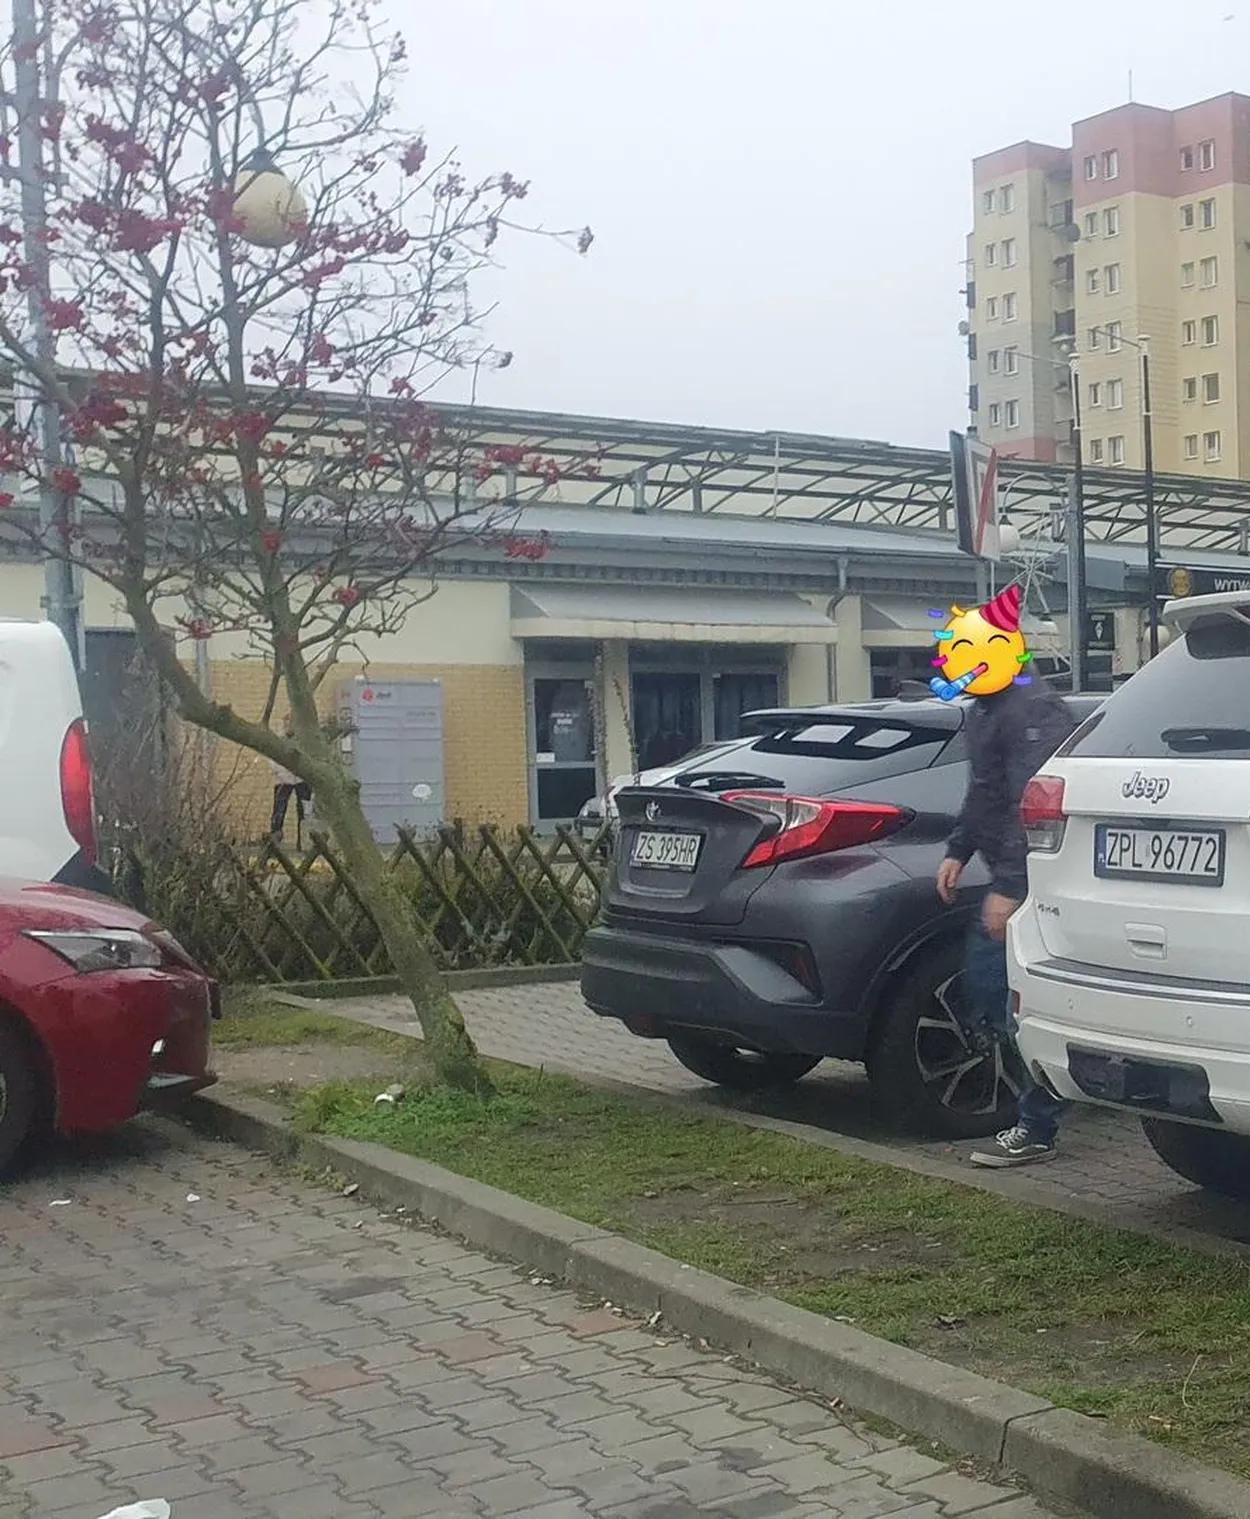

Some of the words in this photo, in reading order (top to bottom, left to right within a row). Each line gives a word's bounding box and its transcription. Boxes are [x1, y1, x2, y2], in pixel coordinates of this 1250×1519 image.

[1122, 771, 1170, 804] Jeep
[636, 834, 656, 860] ZS
[656, 836, 697, 864] 395HR
[1106, 832, 1142, 868] ZPL
[1150, 834, 1218, 873] 96772
